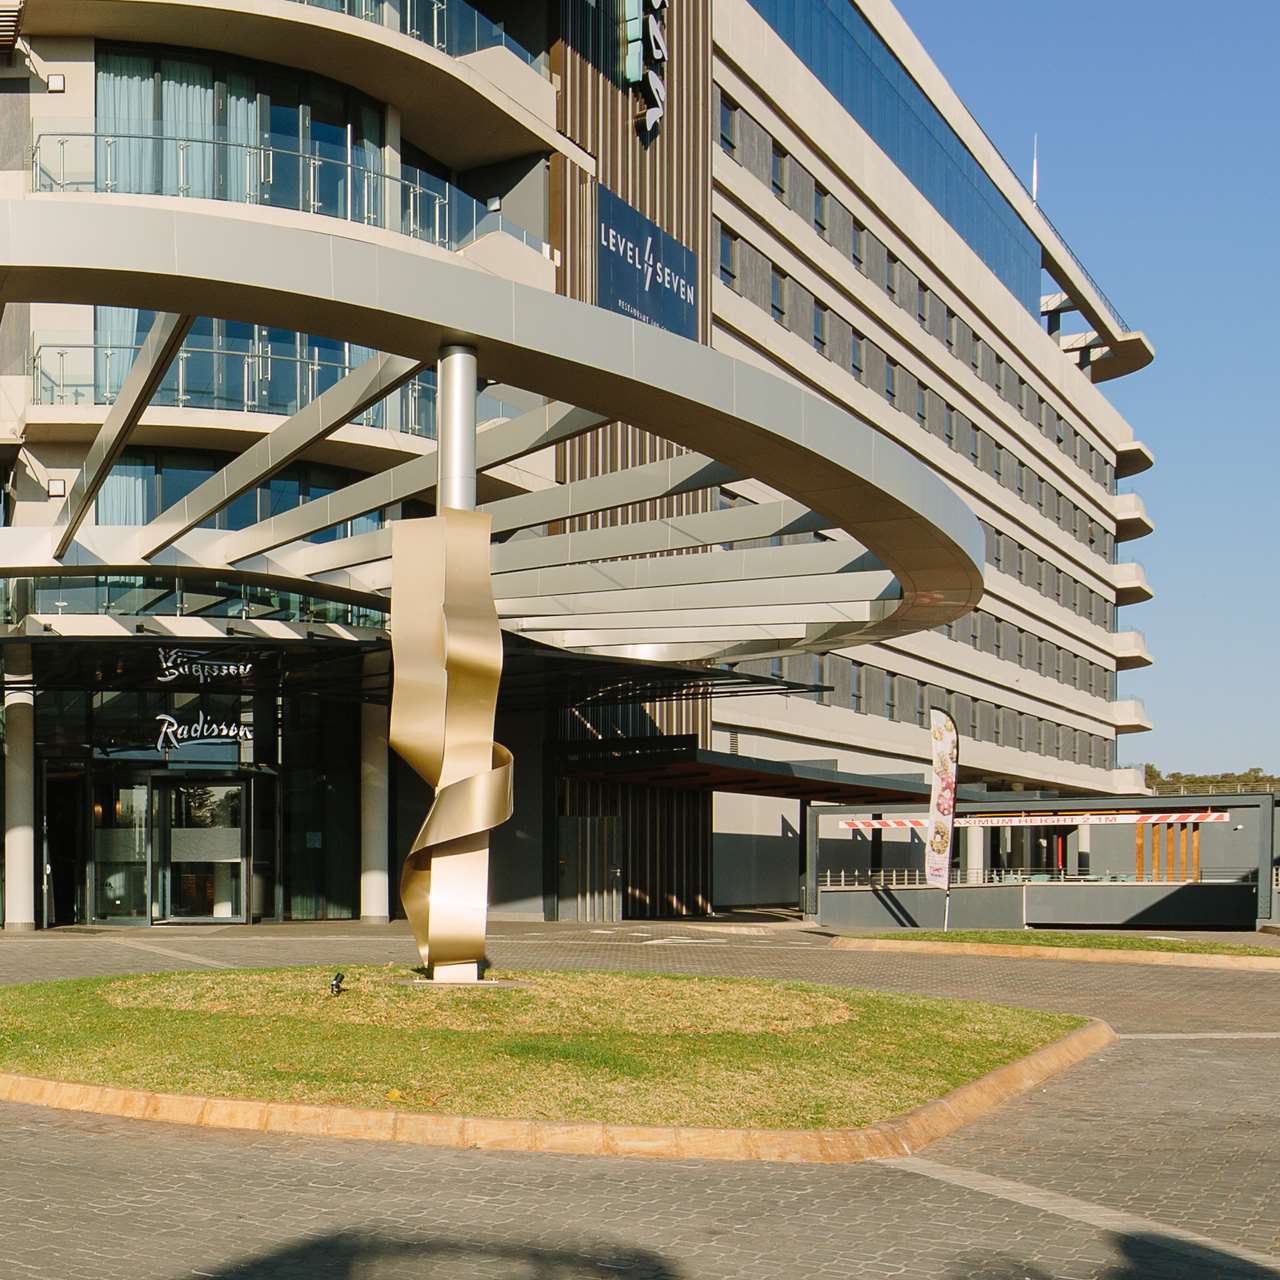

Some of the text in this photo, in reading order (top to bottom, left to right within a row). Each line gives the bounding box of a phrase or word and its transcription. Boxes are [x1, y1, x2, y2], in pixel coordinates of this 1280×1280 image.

[601, 223, 694, 306] LEVEL SEVEN
[155, 710, 253, 752] Radisson
[954, 818, 1014, 826] AXIMUM
